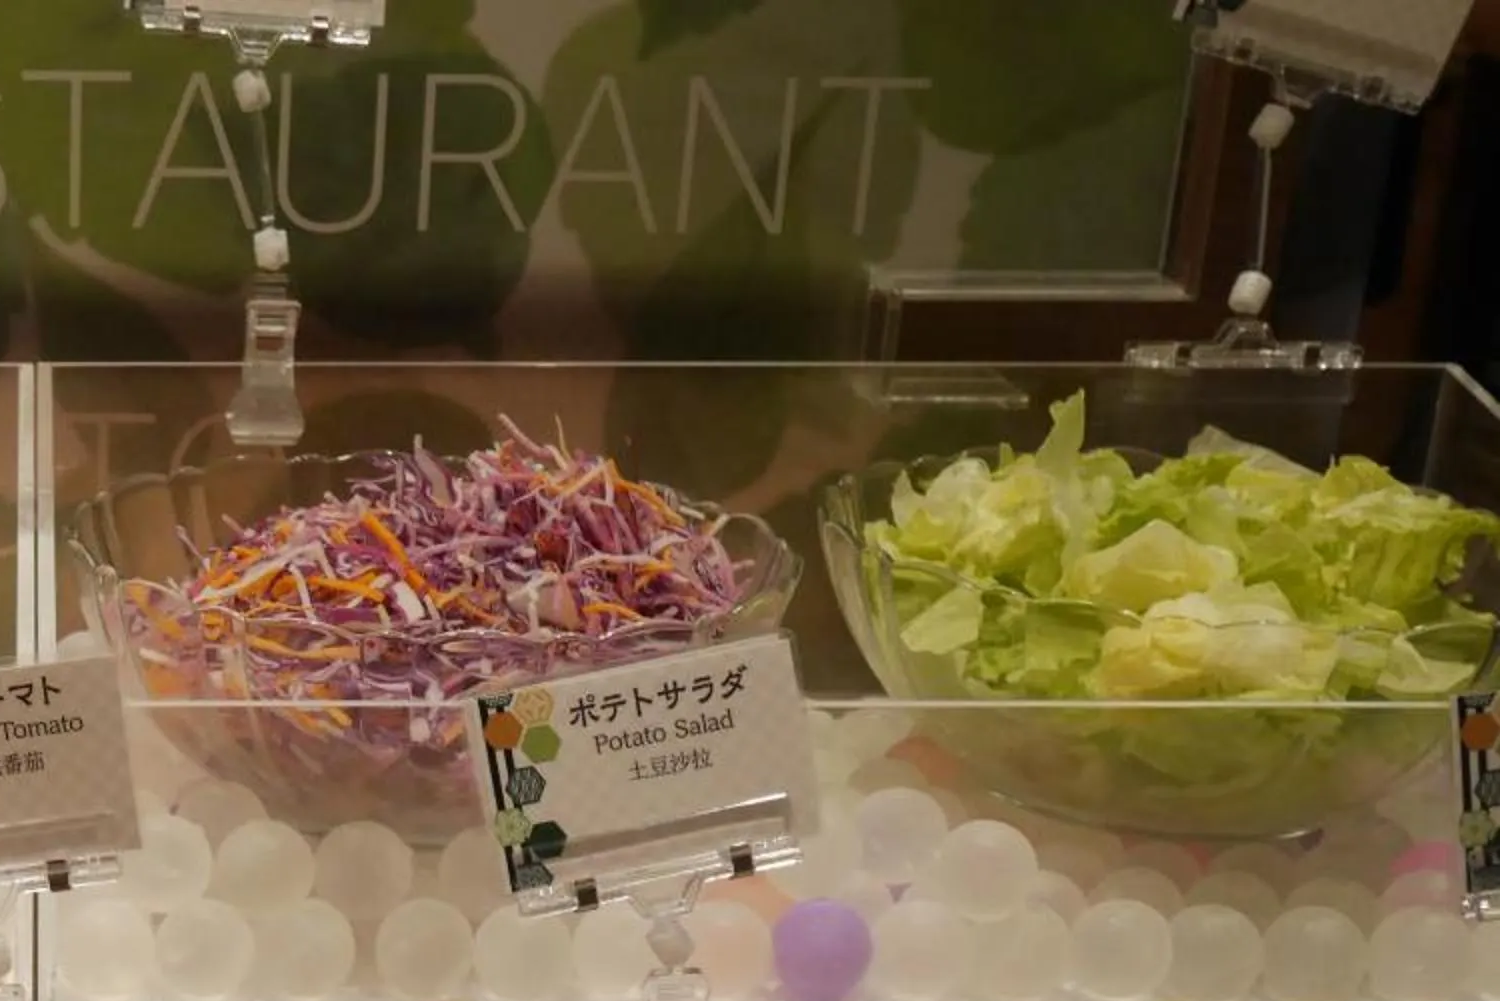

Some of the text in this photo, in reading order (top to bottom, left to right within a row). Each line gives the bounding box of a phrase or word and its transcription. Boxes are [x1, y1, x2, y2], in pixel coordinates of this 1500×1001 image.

[569, 664, 749, 728] ポテトサラダ
[593, 708, 735, 755] Potato Salad
[628, 749, 713, 781] 土豆沙拉
